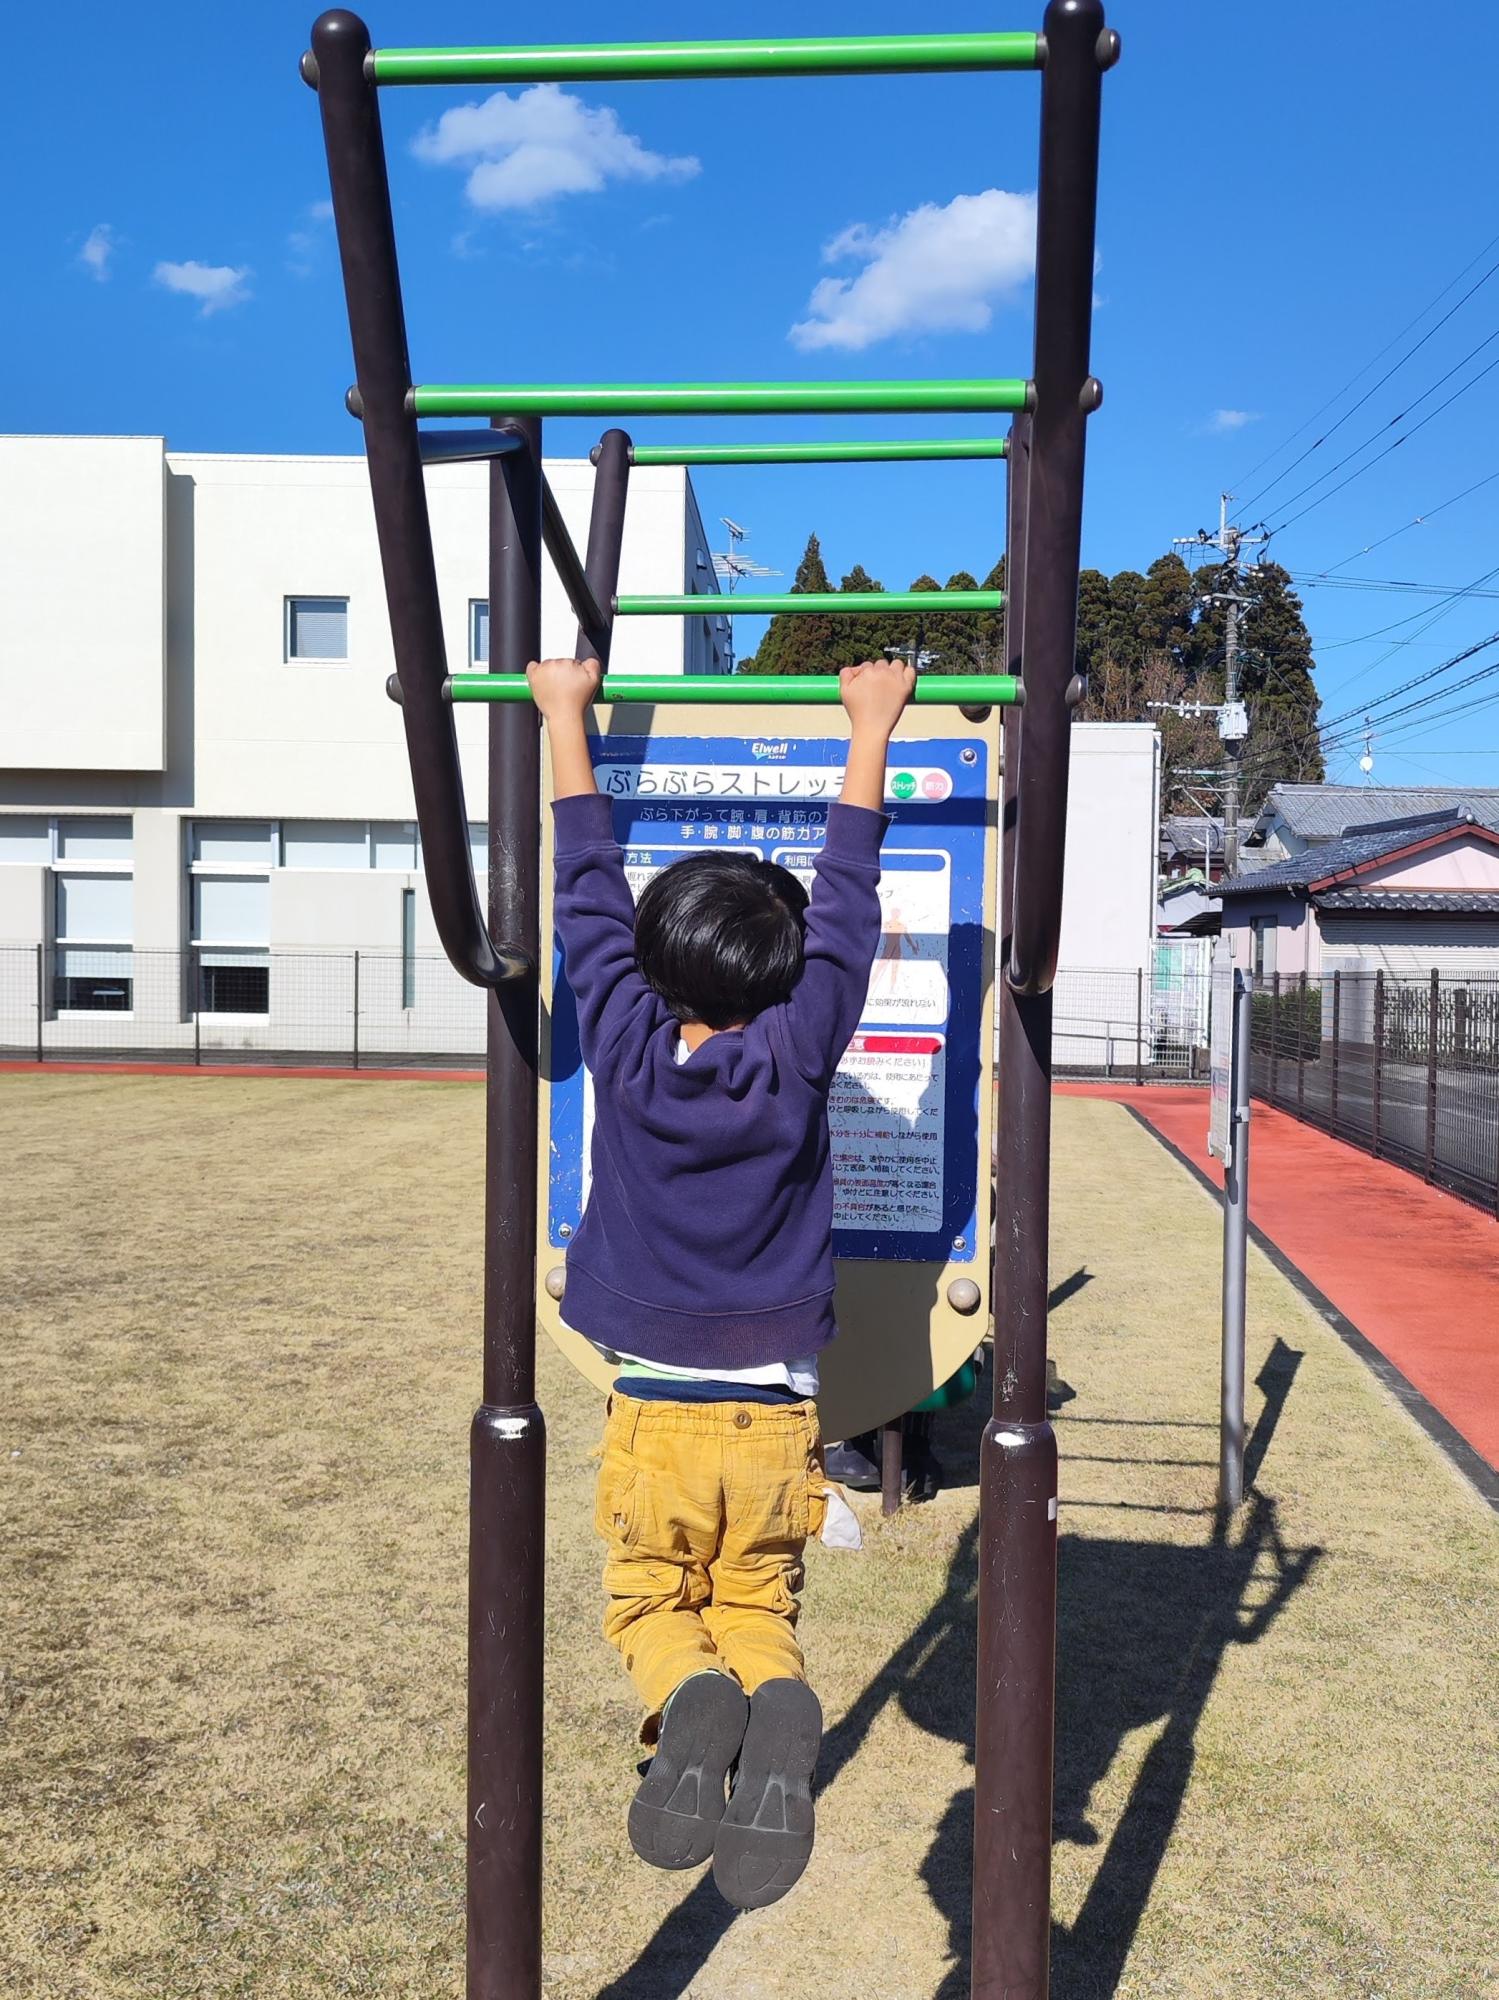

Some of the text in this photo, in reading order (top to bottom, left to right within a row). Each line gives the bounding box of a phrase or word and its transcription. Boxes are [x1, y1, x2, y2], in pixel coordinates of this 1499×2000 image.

[751, 742, 788, 754] Elwell
[891, 780, 917, 792] ストレッチ
[680, 825, 826, 841] 手・腕・脚・腹の筋力ア
[626, 851, 653, 865] 方法
